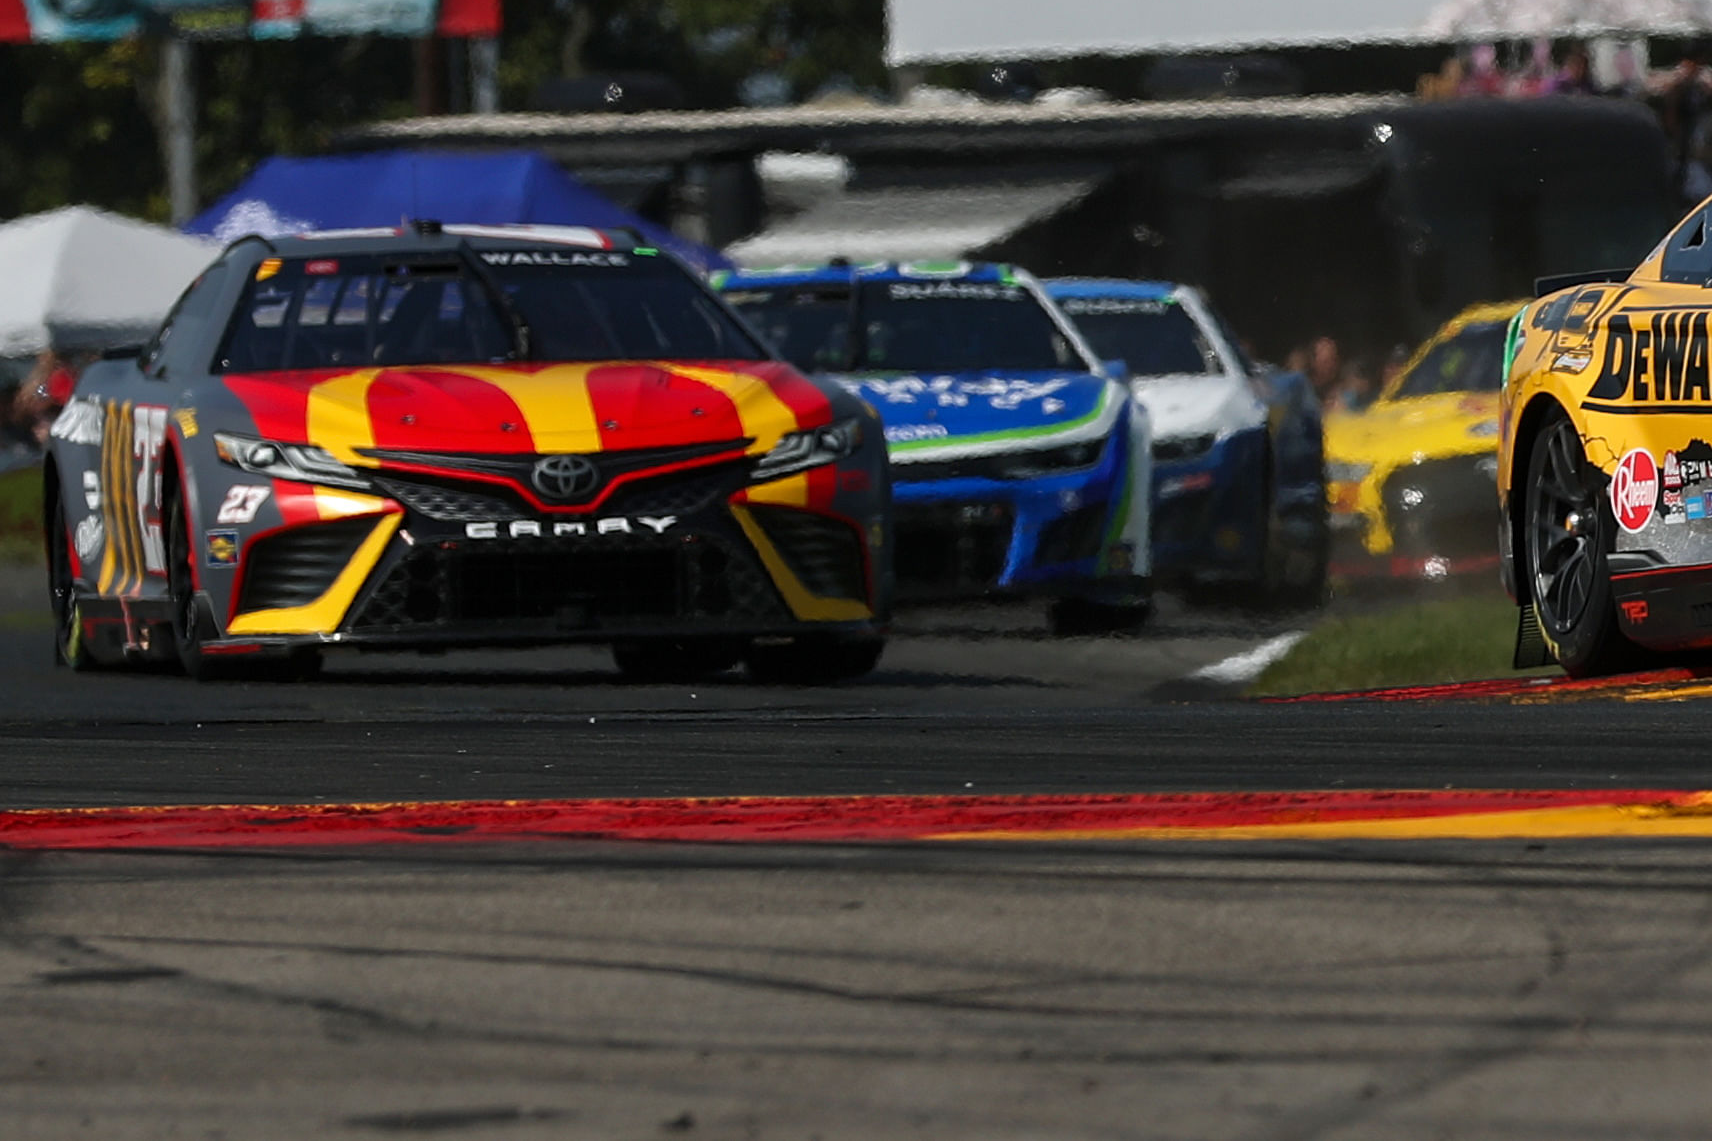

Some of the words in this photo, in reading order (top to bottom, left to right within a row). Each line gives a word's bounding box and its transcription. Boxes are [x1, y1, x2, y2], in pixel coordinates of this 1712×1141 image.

[480, 252, 630, 266] WALLACE
[217, 484, 272, 524] 23
[1616, 451, 1656, 520] Rheem
